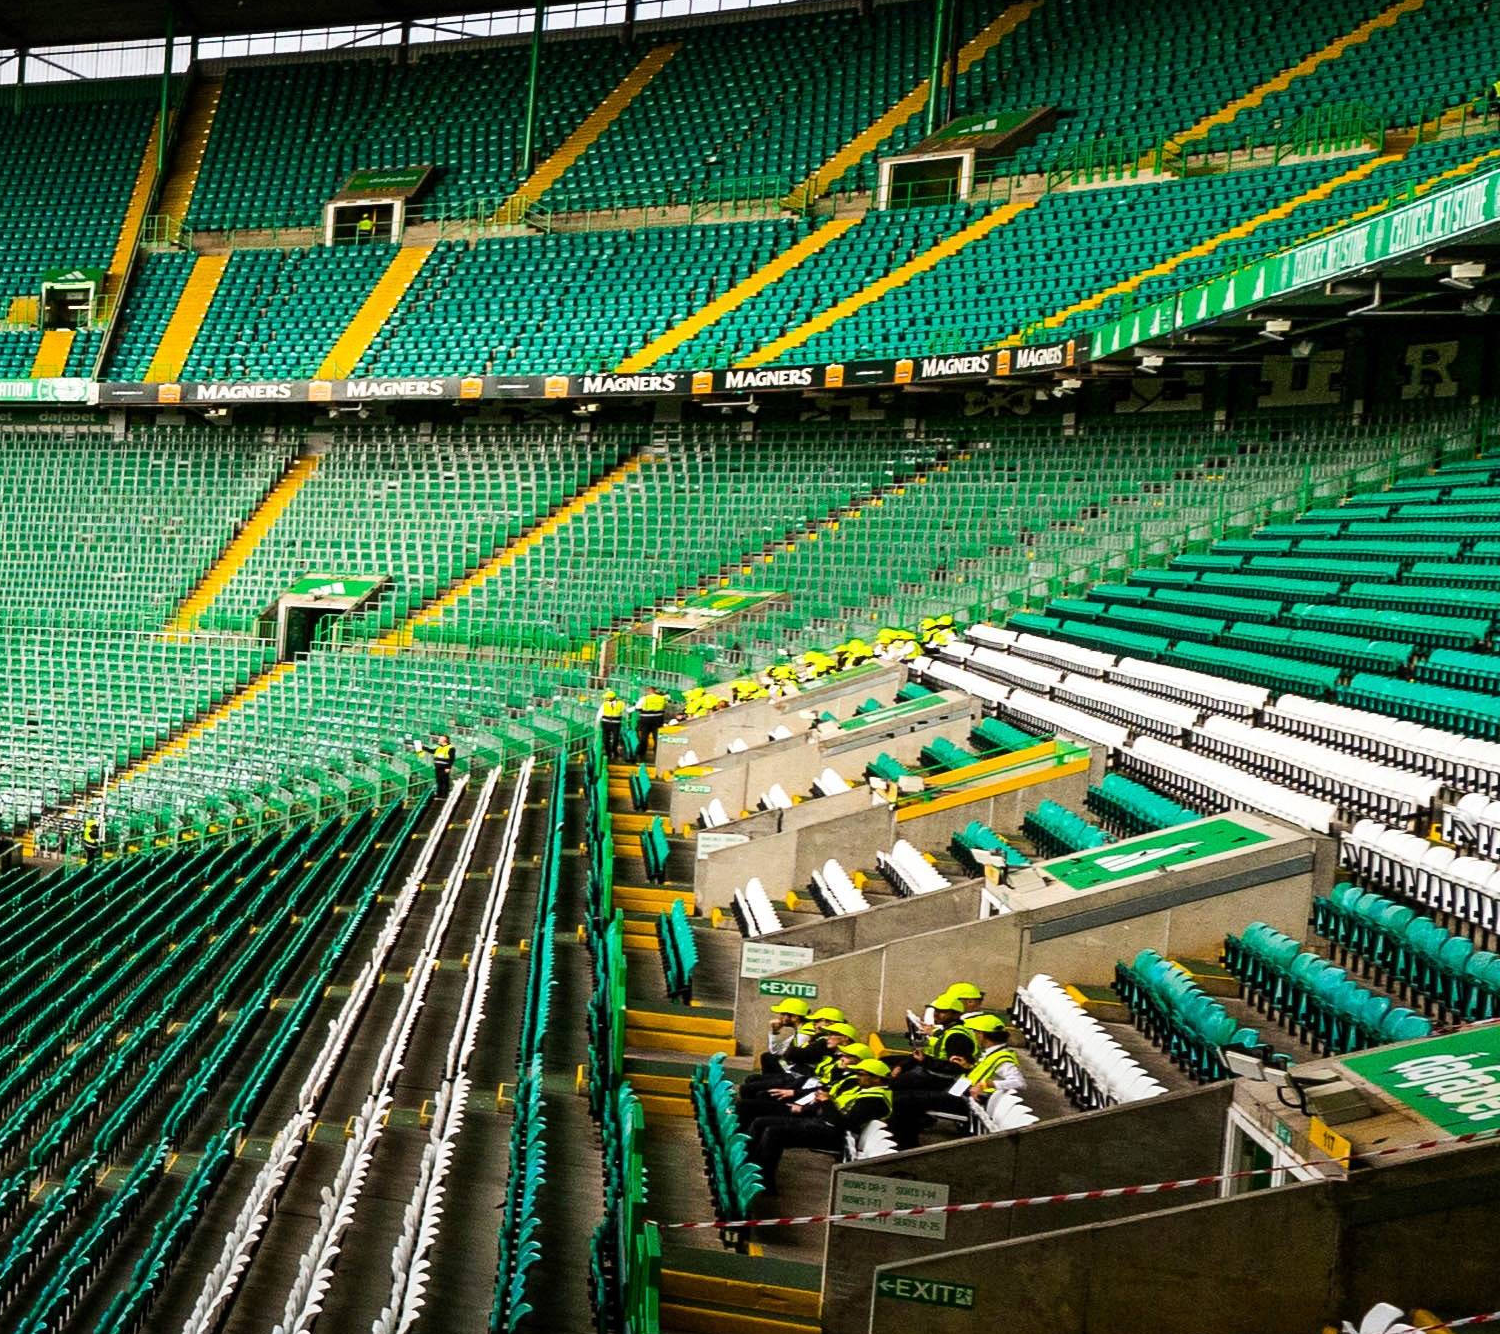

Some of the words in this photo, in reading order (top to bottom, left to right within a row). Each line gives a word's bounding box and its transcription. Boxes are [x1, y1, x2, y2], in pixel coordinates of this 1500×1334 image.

[922, 354, 990, 378] MAGNERS
[1017, 347, 1063, 368] MAGNERS
[583, 375, 676, 394] MAGNERS
[726, 367, 812, 388] MAGNERS
[197, 383, 292, 401] MAGNERS
[346, 379, 444, 397] MAGNERS
[770, 982, 805, 996] EXIT
[896, 1278, 955, 1302] EXIT
